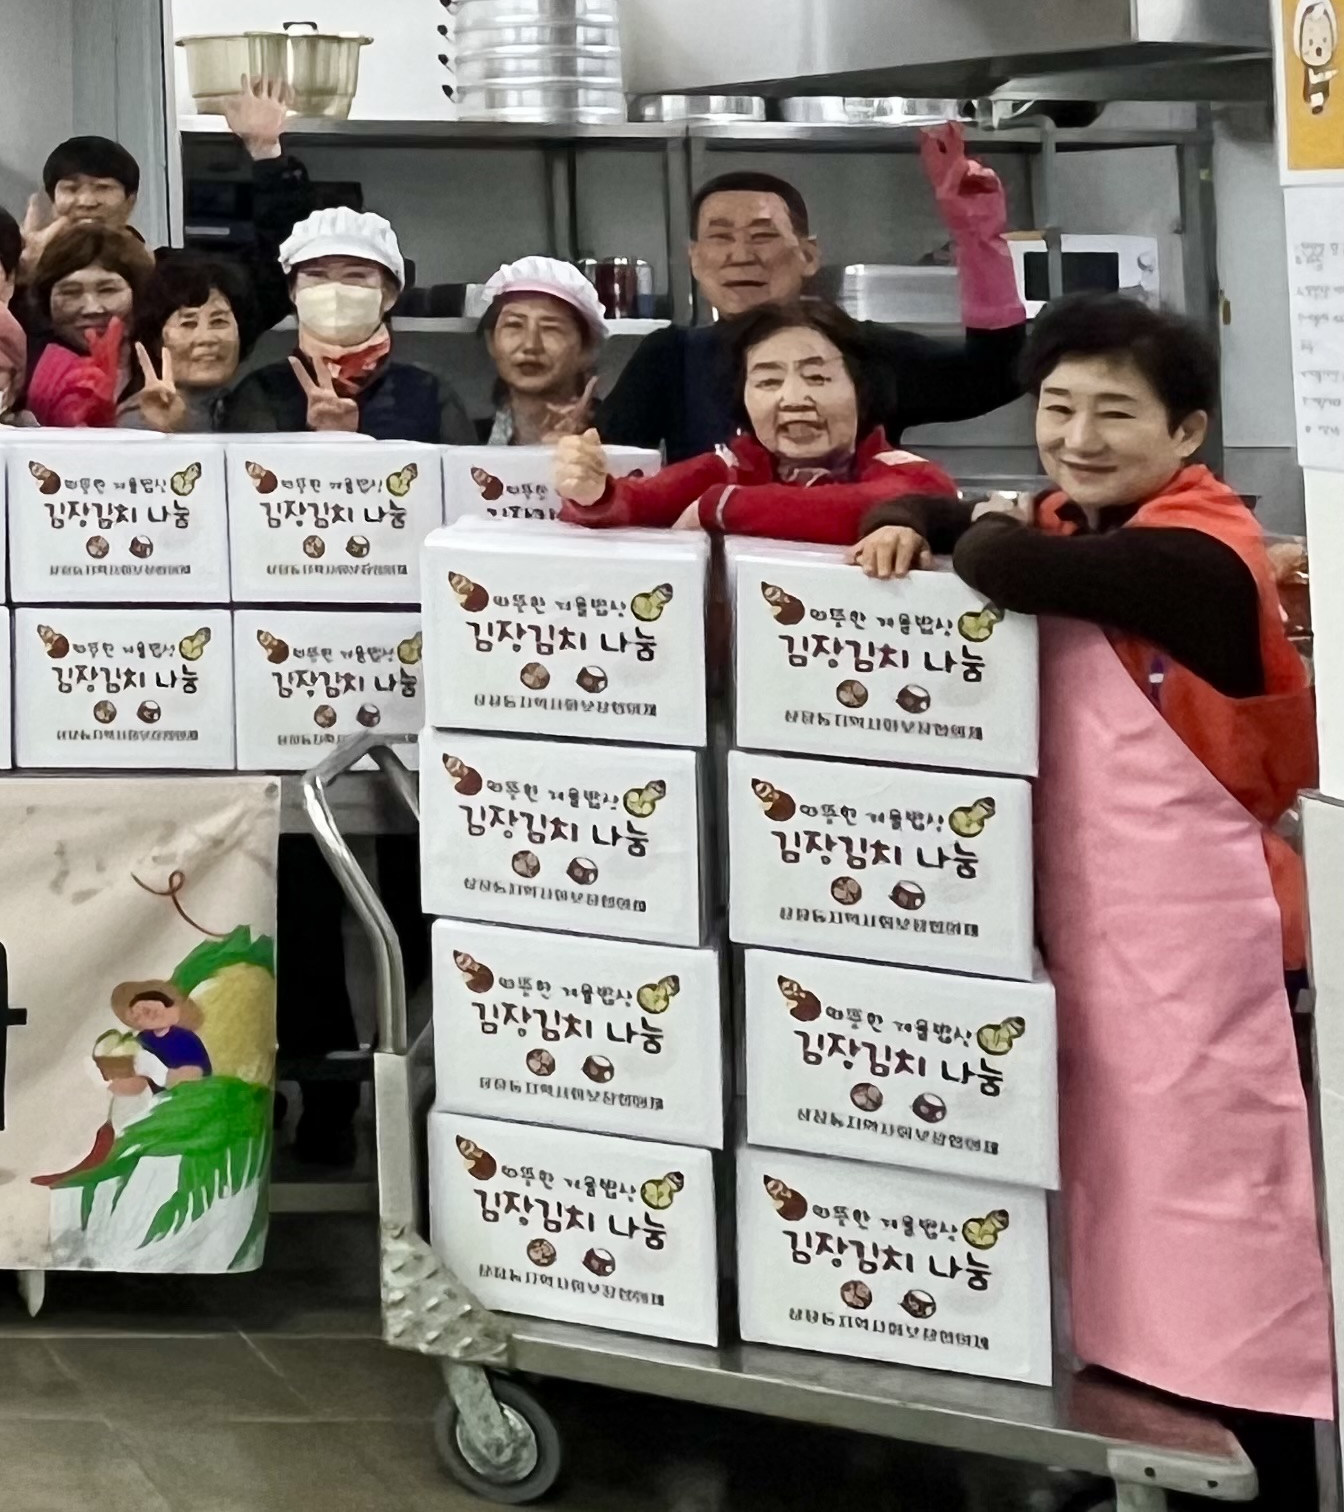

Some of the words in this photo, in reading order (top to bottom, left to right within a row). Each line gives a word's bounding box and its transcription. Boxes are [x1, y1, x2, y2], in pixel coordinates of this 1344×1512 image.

[44, 501, 137, 529] 김장김치
[148, 500, 190, 529] 나눔
[260, 500, 353, 529] 김장김치
[364, 499, 407, 529] 나눔
[465, 620, 586, 656] 김장김치
[600, 626, 657, 662] 나눔
[778, 634, 909, 672] 김장김치
[924, 645, 986, 682] 나눔
[52, 665, 145, 694] 김장김치
[156, 664, 199, 694] 나눔
[272, 669, 364, 698] 김장김치
[375, 667, 417, 698] 나눔
[459, 805, 578, 844] 김장김치
[592, 820, 649, 857] 나눔
[771, 830, 902, 870] 김장김치
[917, 840, 979, 879] 나눔
[471, 1002, 592, 1041] 김장김치
[607, 1016, 664, 1054] 나눔
[793, 1030, 926, 1077] 김장김치
[941, 1057, 1004, 1097] 나눔
[473, 1189, 594, 1233] 김장김치
[608, 1211, 667, 1250] 나눔
[782, 1230, 914, 1274] 김장김치
[929, 1251, 992, 1291] 나눔
